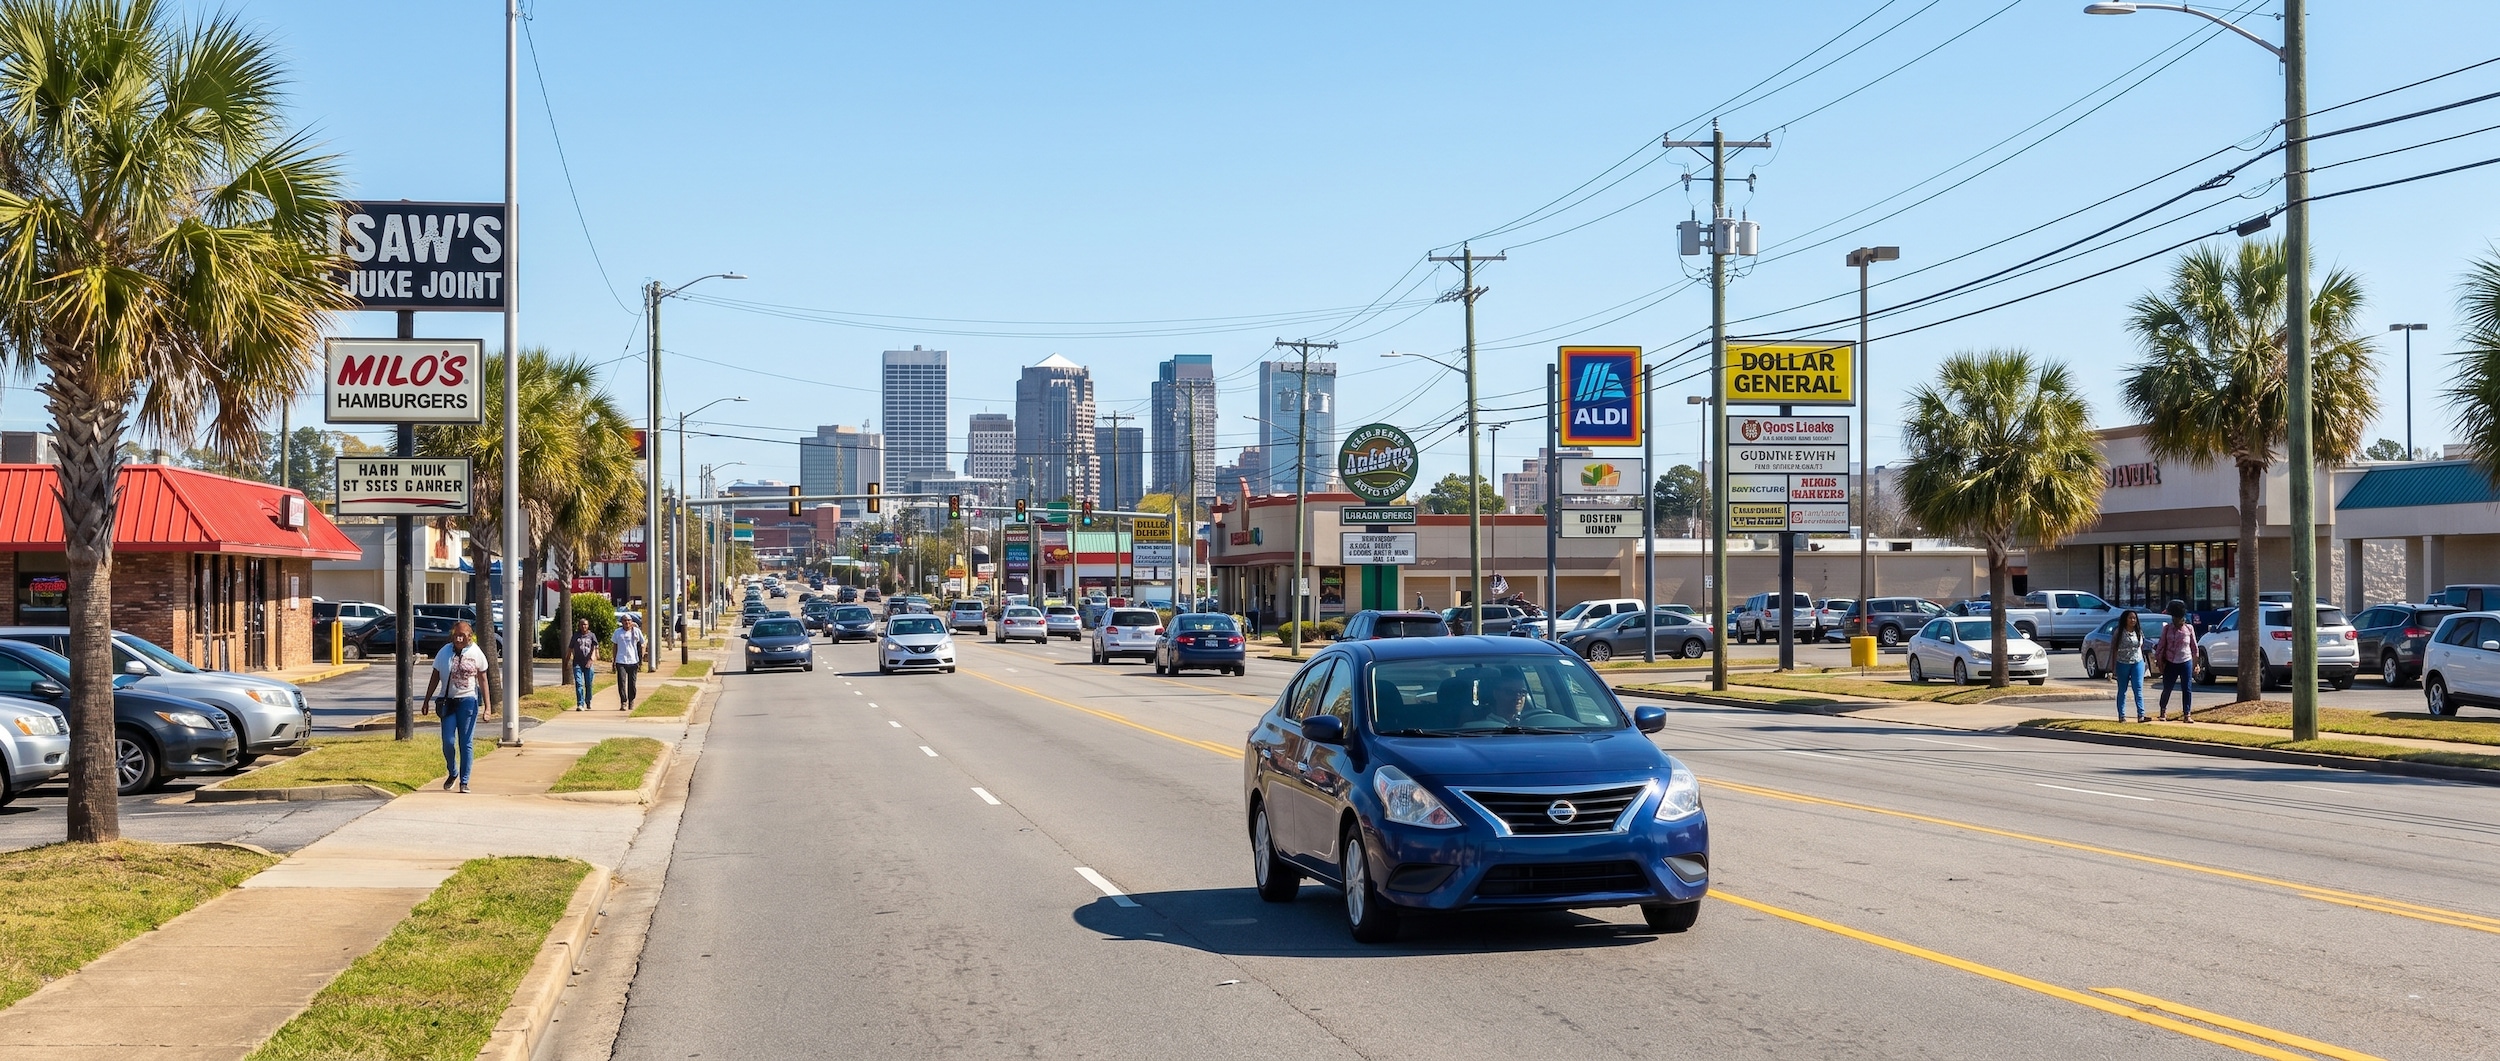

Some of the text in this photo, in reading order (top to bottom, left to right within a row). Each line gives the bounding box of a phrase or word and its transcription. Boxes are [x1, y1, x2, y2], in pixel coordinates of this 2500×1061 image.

[341, 270, 502, 299] JUKE JOINT
[337, 350, 468, 387] MILO'S
[1740, 352, 1836, 371] DOLLAR
[1734, 374, 1842, 393] GENERAL
[337, 393, 468, 409] HAMBURGERS
[1573, 407, 1628, 425] ALDI
[343, 480, 359, 492] ST
[366, 480, 398, 492] SSES
